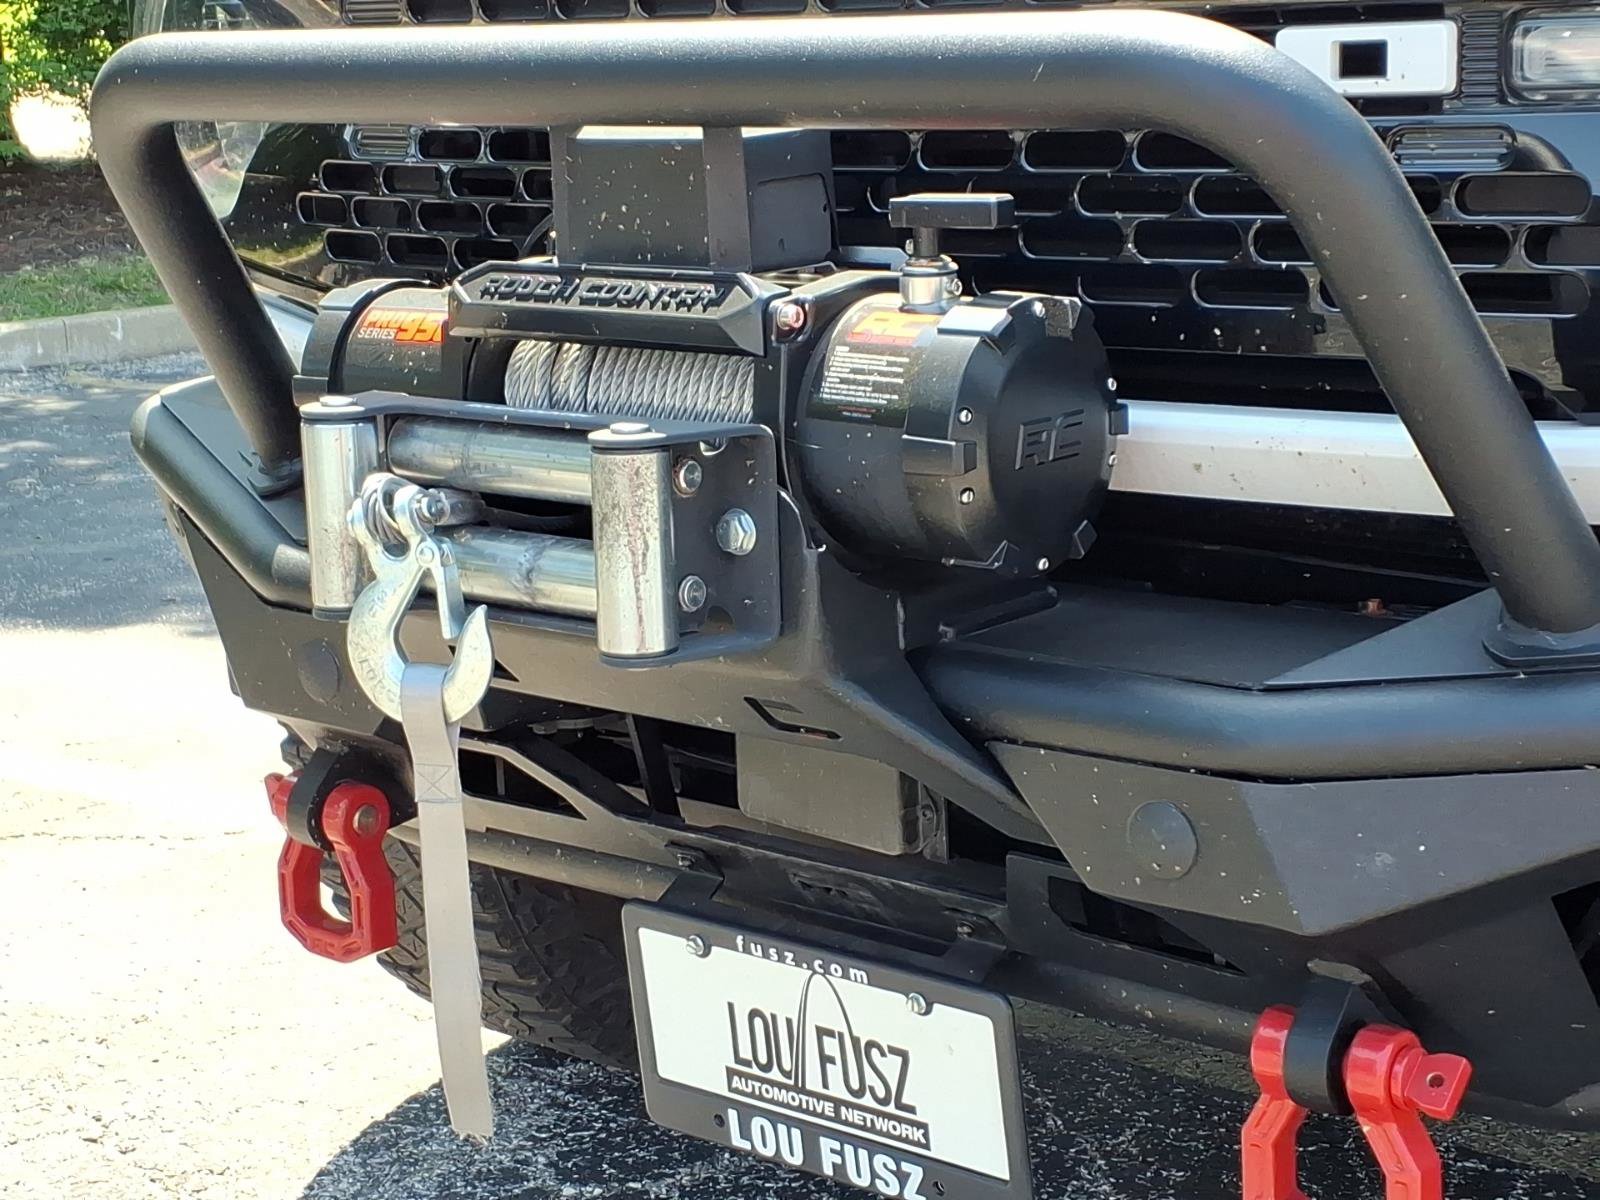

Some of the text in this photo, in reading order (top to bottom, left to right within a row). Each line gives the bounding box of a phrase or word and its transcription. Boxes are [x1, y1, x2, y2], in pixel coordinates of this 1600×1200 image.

[480, 275, 725, 312] ROUGH COUNTRY
[357, 328, 398, 339] SERIES
[735, 934, 869, 985] fusz.com
[727, 1001, 918, 1117] LOU FUSZ
[731, 1075, 927, 1144] AUTOMOTIVE NETWORK
[727, 1108, 927, 1200] LOU FUSZ
